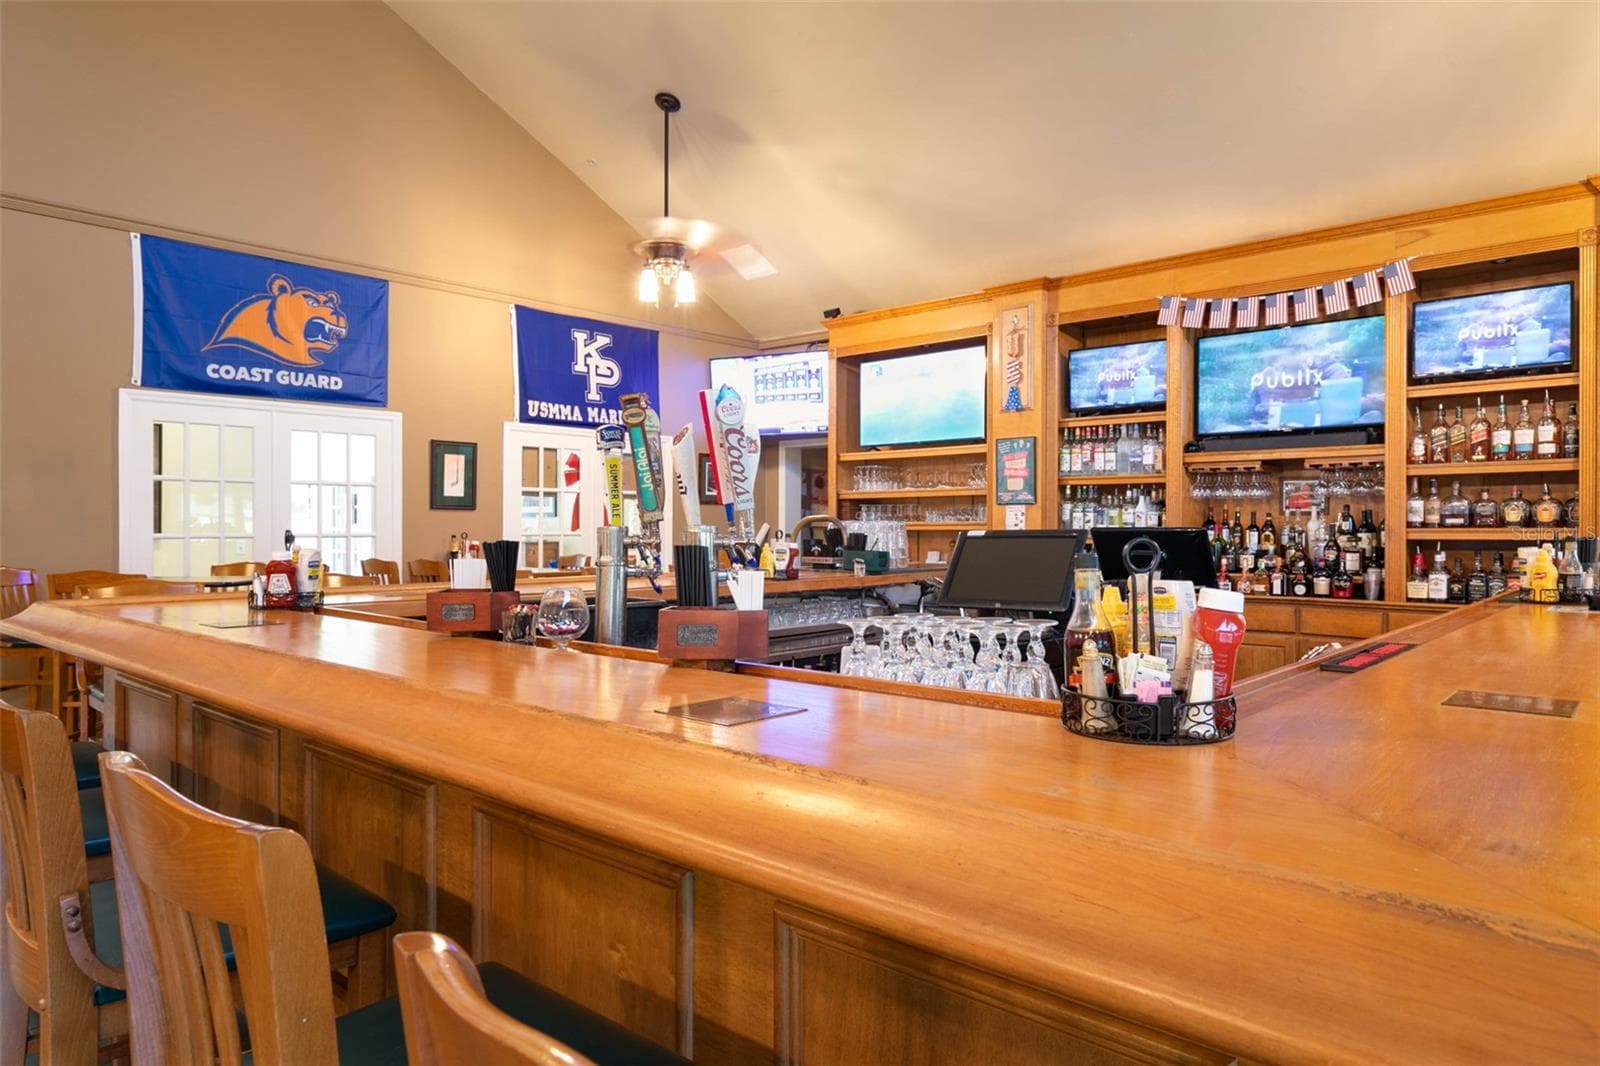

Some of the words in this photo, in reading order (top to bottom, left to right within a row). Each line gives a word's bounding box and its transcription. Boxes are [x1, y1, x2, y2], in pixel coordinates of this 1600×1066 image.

[206, 363, 273, 383] COAST
[276, 370, 343, 390] GUARD
[571, 328, 622, 404] KP
[527, 400, 583, 421] USMMA
[724, 425, 750, 497] Coors
[609, 463, 620, 500] SUMMER
[639, 471, 653, 491] Jai
[611, 503, 621, 519] ALE
